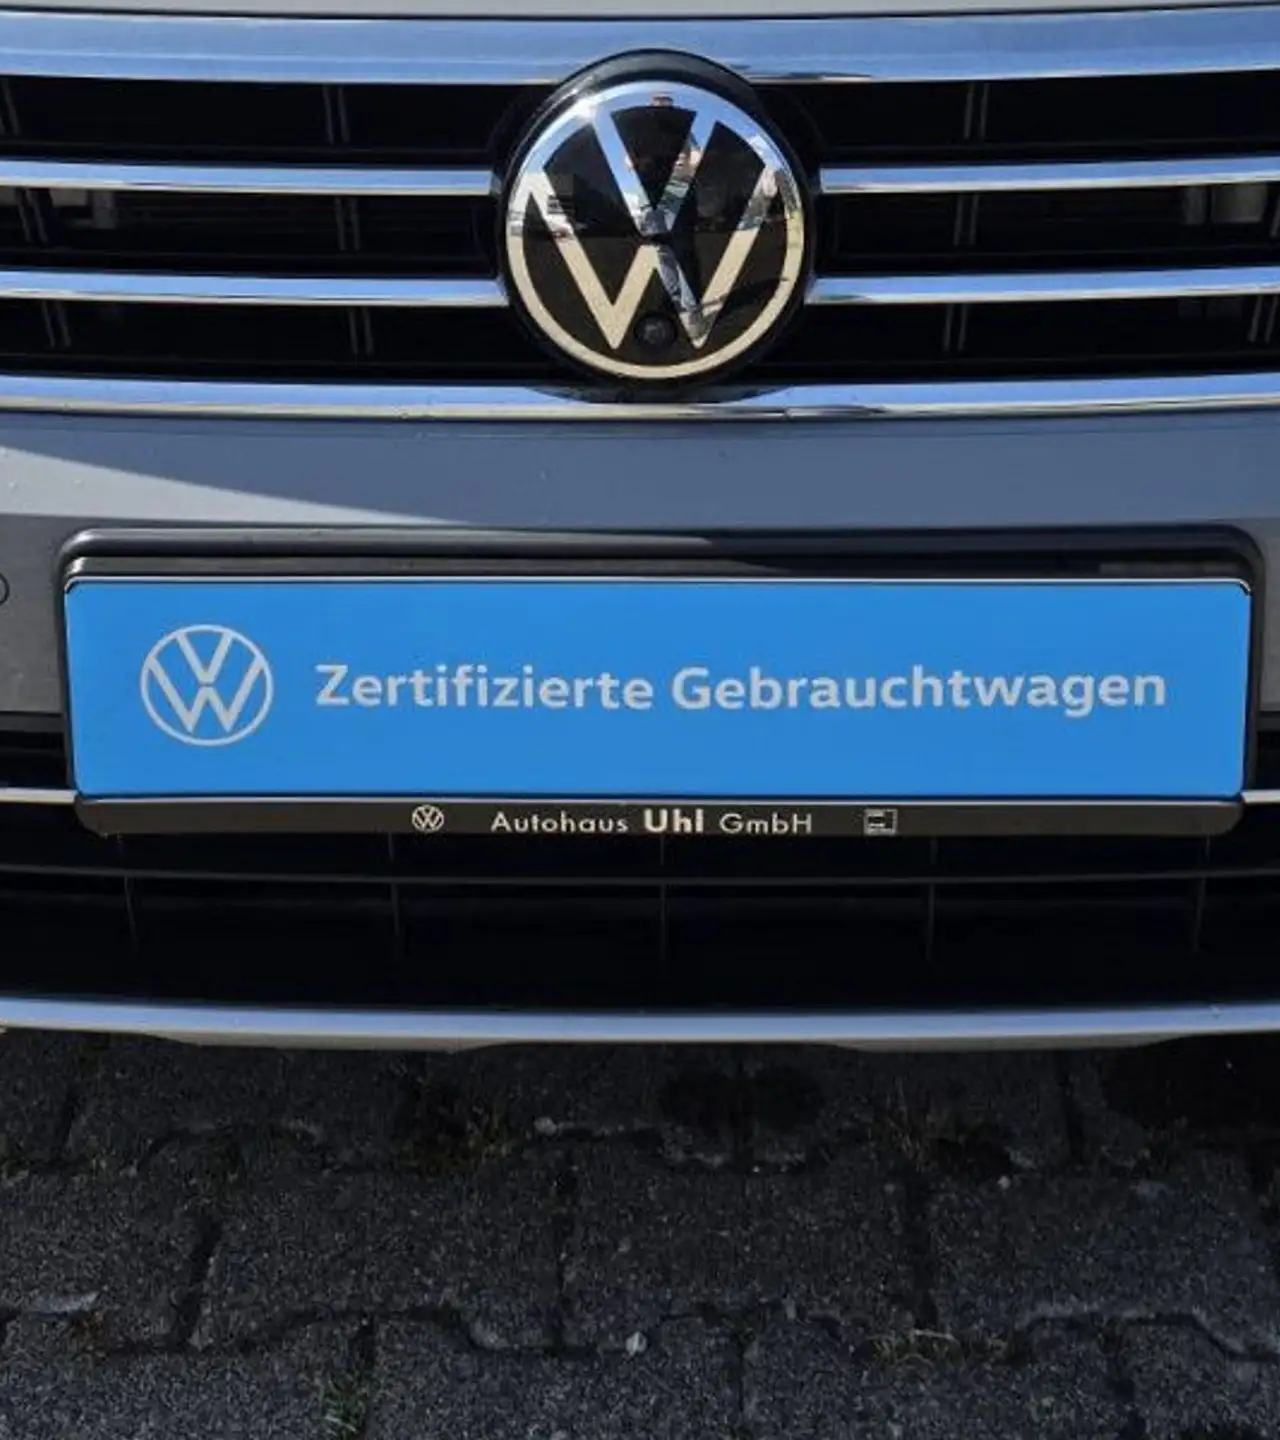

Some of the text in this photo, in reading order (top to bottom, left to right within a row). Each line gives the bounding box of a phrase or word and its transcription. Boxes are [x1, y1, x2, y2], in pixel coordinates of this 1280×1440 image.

[506, 80, 806, 378] VW
[140, 624, 274, 746] VW
[315, 664, 1167, 718] Zertifizierte Gebrauchtwagen
[490, 808, 812, 835] Autohaus Uhl GmbH
